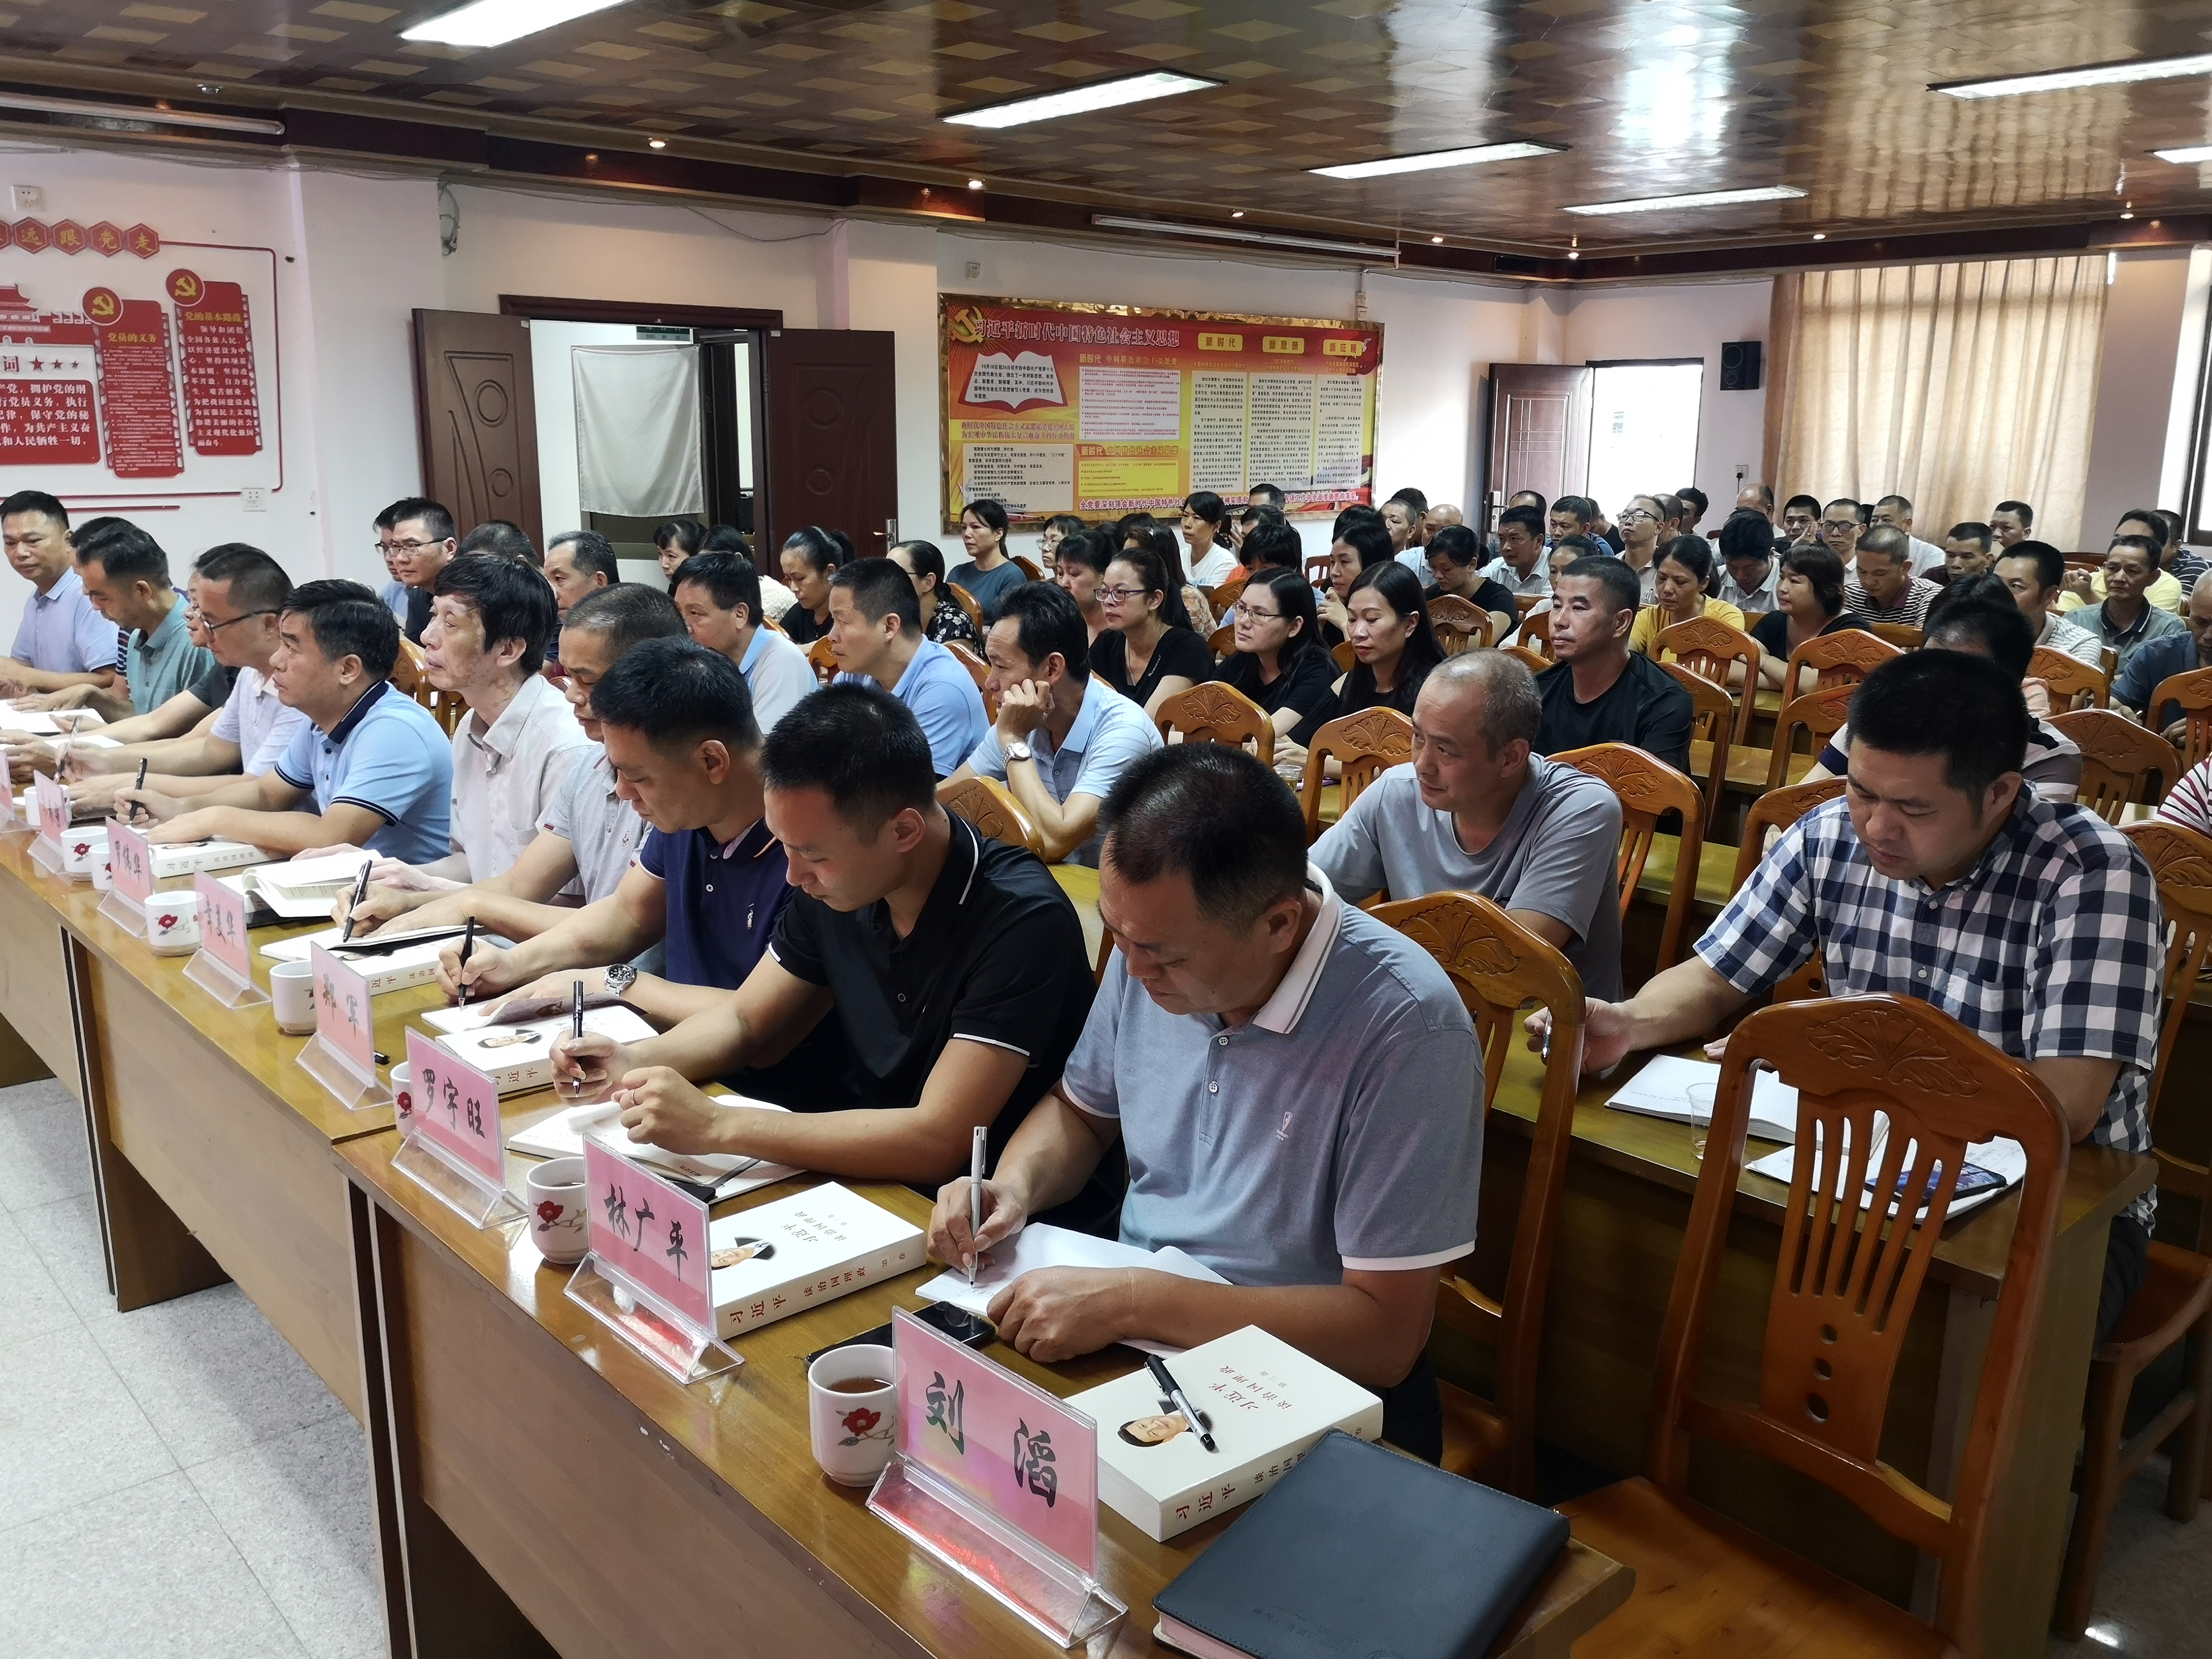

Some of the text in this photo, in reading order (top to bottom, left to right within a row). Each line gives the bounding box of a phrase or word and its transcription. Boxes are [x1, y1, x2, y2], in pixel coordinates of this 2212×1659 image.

[108, 333, 157, 344] 党员的义务
[974, 318, 1181, 348] 习近平新时代中国特色社会主义思想
[1206, 336, 1236, 348] 新时代
[1079, 353, 1178, 366] 新时代 中国特色社会主义思想
[0, 435, 86, 446] 和人民牺牲一切，
[1081, 445, 1179, 456] 新时代 中国特色社会主义思想
[603, 1183, 688, 1282] 林广平
[781, 1224, 818, 1243] 习近平
[729, 1294, 787, 1325] 习近平
[803, 1265, 866, 1297] 谈治国理政
[1208, 1382, 1260, 1412] 习近平
[1219, 1365, 1293, 1410] 谈治国理政
[925, 1370, 1058, 1508] 刘滔
[1175, 1483, 1236, 1522] 习近平
